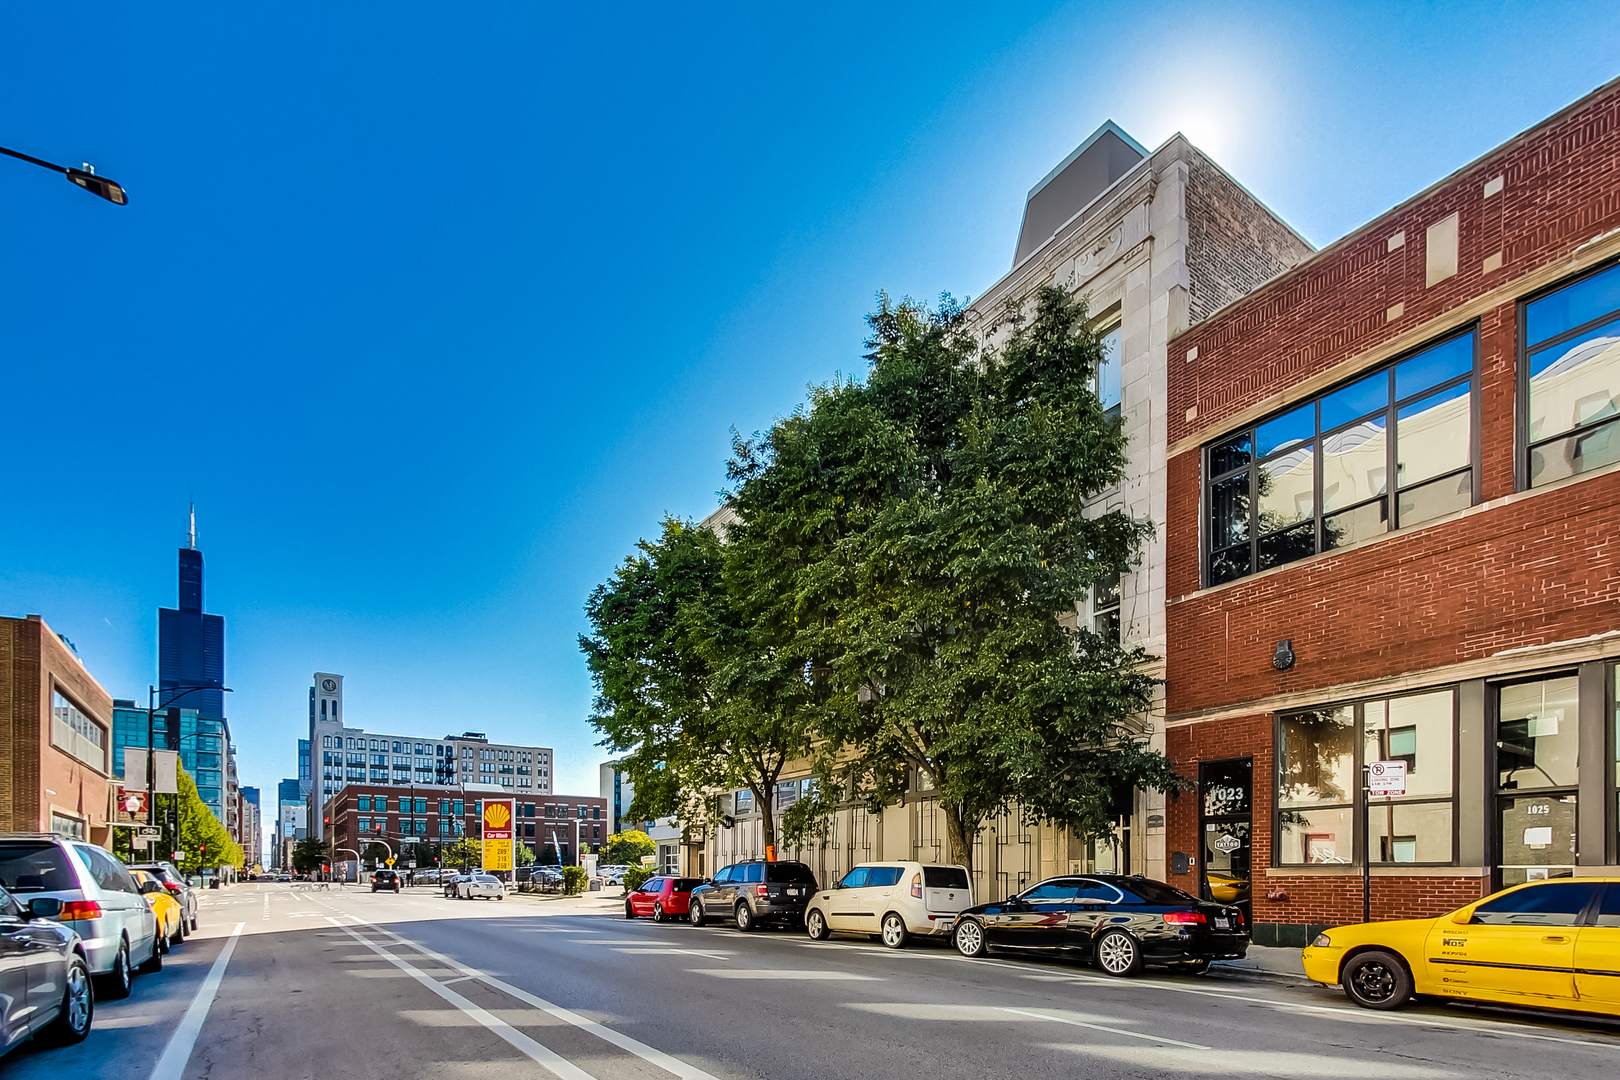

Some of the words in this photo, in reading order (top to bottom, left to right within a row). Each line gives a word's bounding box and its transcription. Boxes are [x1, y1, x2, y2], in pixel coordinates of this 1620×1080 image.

[1210, 787, 1244, 801] 1023
[1527, 804, 1550, 814] 1025
[1442, 938, 1465, 947] NOS
